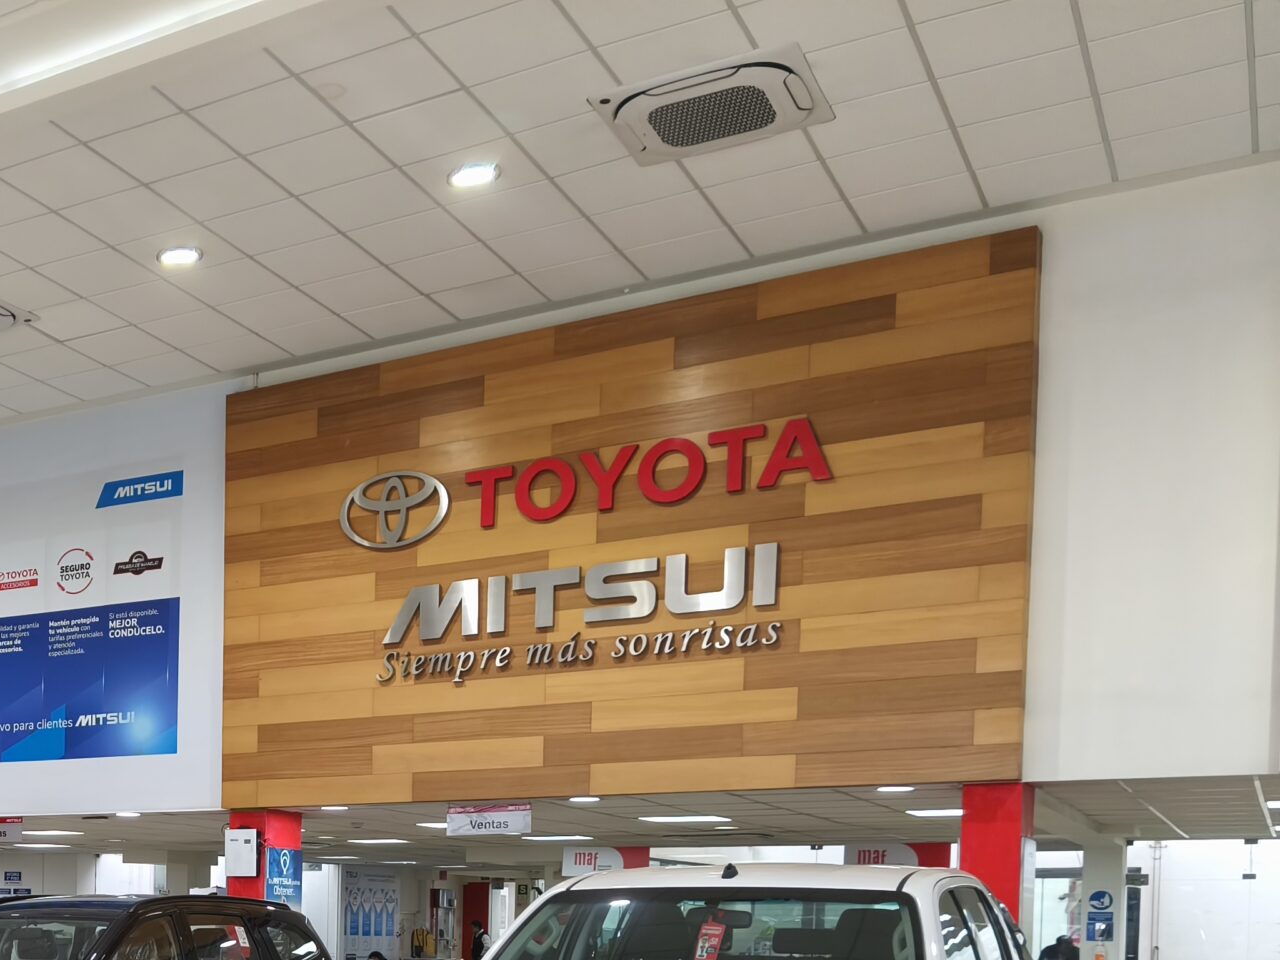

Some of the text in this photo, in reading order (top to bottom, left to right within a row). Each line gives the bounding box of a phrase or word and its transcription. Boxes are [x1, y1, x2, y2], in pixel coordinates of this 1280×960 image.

[464, 417, 834, 529] TOYOTA
[114, 479, 173, 499] MITSUI
[6, 568, 39, 580] TOYOTA
[60, 562, 91, 574] SEGURO
[60, 571, 91, 582] TOYOTA
[0, 582, 31, 590] ACCESORIOS
[381, 542, 780, 645] MITSUI
[115, 611, 128, 619] está
[18, 622, 40, 631] garantía
[49, 616, 100, 628] Mantén protegido
[9, 631, 30, 640] mejores
[49, 634, 65, 642] tarifas
[375, 619, 783, 684] Siempre más sonrisas
[12, 720, 35, 734] para
[36, 716, 73, 730] clientes
[75, 711, 136, 728] MITSUI
[469, 818, 509, 830] Ventas
[574, 852, 599, 871] maf
[857, 849, 887, 865] maf
